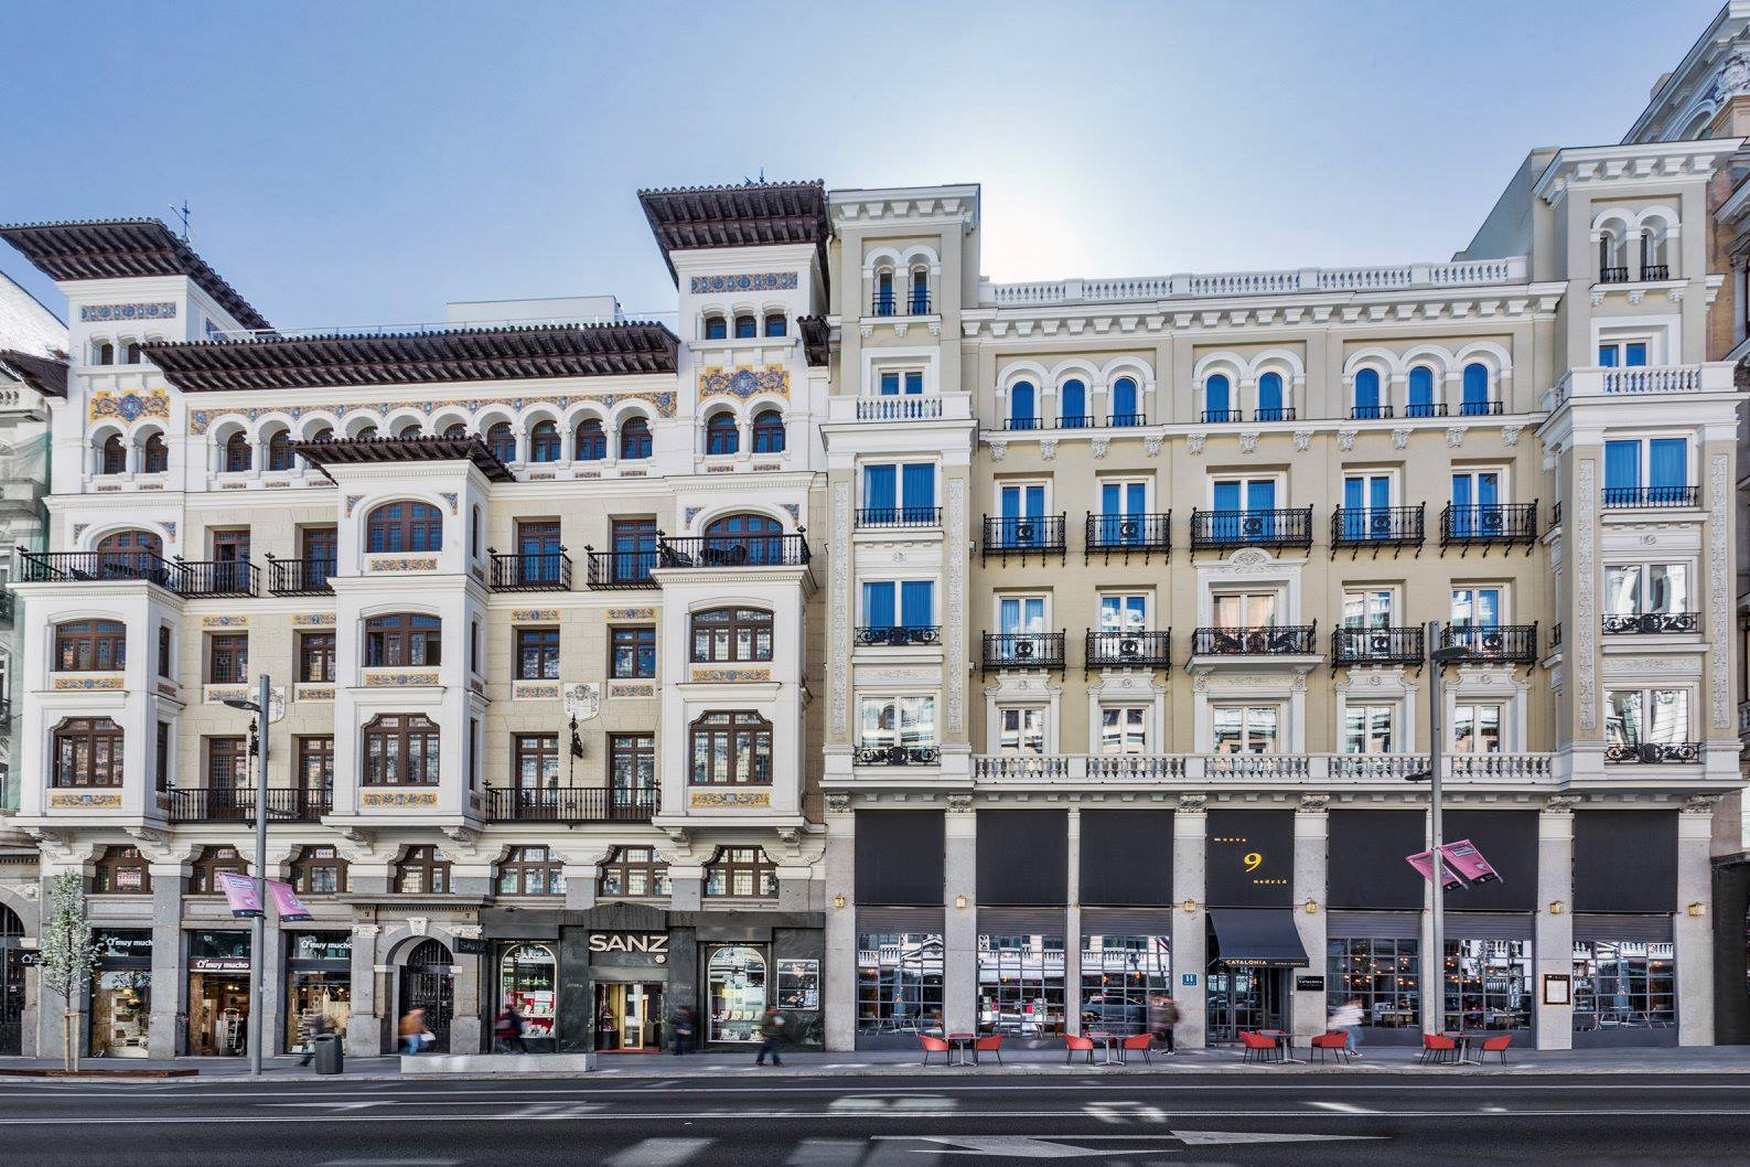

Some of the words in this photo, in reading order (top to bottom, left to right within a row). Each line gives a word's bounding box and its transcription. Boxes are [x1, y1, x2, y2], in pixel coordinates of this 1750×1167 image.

[1243, 852, 1262, 873] 9
[115, 939, 132, 947] muy
[588, 934, 669, 953] SANZ
[205, 960, 222, 969] muy
[223, 960, 249, 968] mucho
